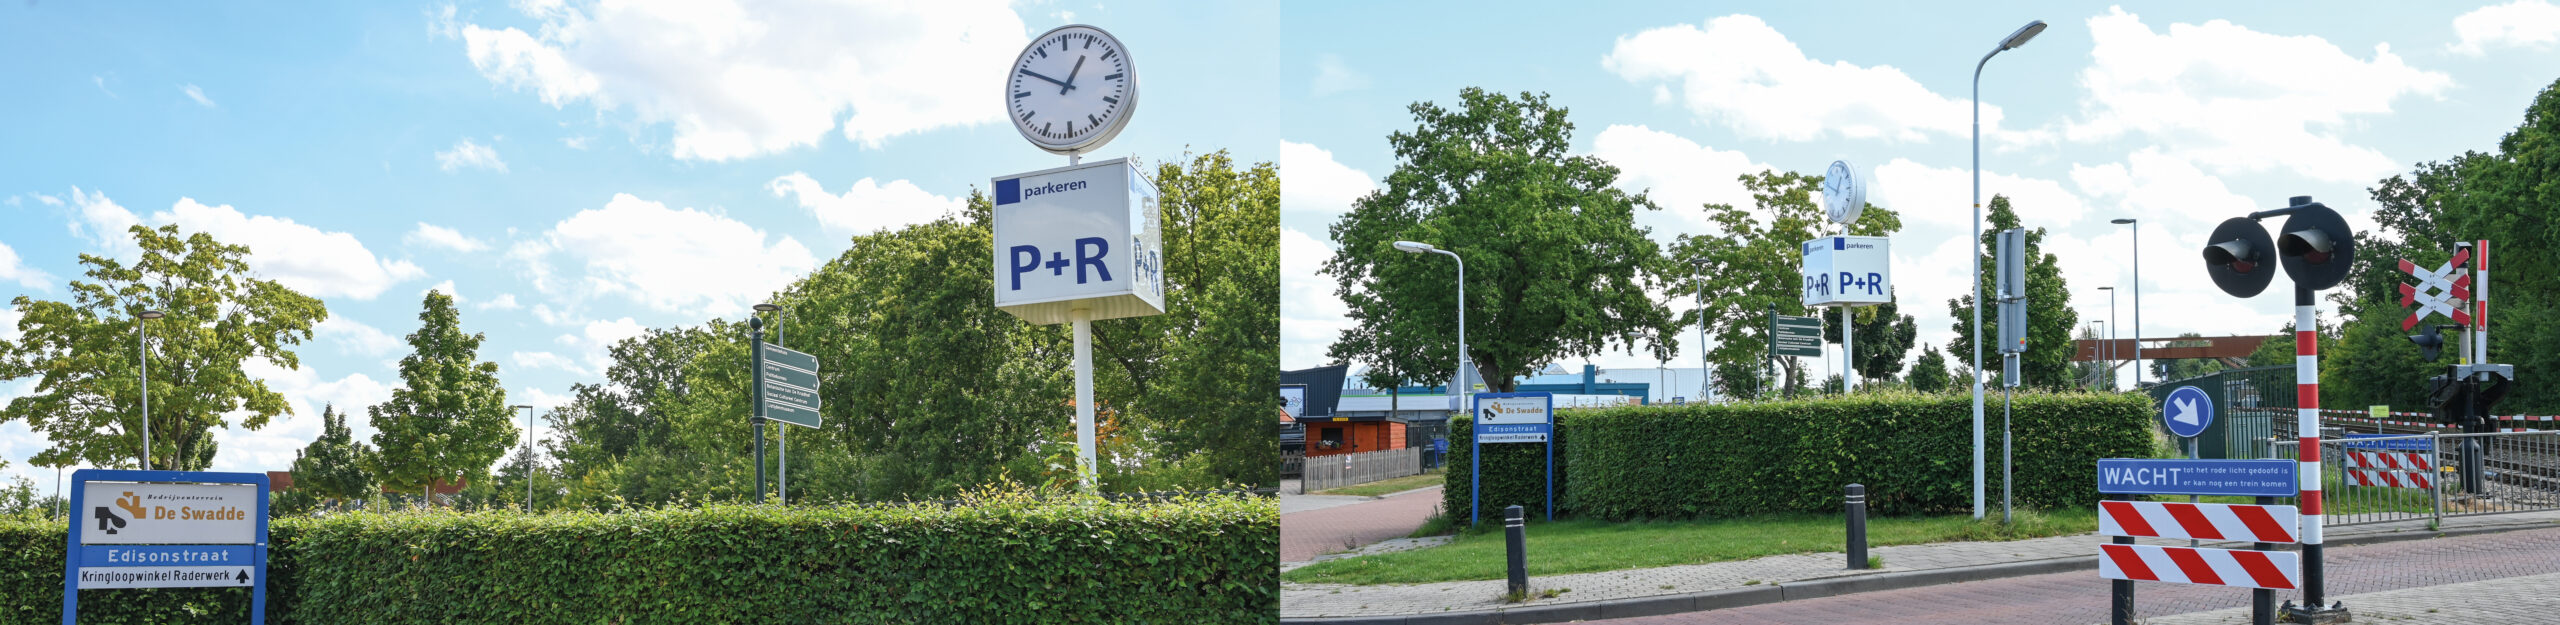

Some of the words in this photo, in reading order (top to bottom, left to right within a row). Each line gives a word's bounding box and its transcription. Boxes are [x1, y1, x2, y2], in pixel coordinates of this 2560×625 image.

[1024, 178, 1087, 200] parkeren
[1846, 242, 1874, 250] parkeren
[1010, 236, 1113, 291] P+R
[1133, 235, 1160, 297] P+R
[1806, 272, 1829, 298] P+R
[1839, 271, 1883, 296] P+R
[1516, 406, 1544, 414] Swadde
[2104, 467, 2181, 486] WACHT
[2248, 467, 2278, 476] gedoofd
[2261, 480, 2287, 488] komen
[154, 505, 176, 520] De
[181, 505, 245, 521] Swadde
[108, 549, 229, 562] Edisonstraat
[81, 570, 171, 584] Kringloopwinkel
[173, 570, 230, 581] Raderwerk
